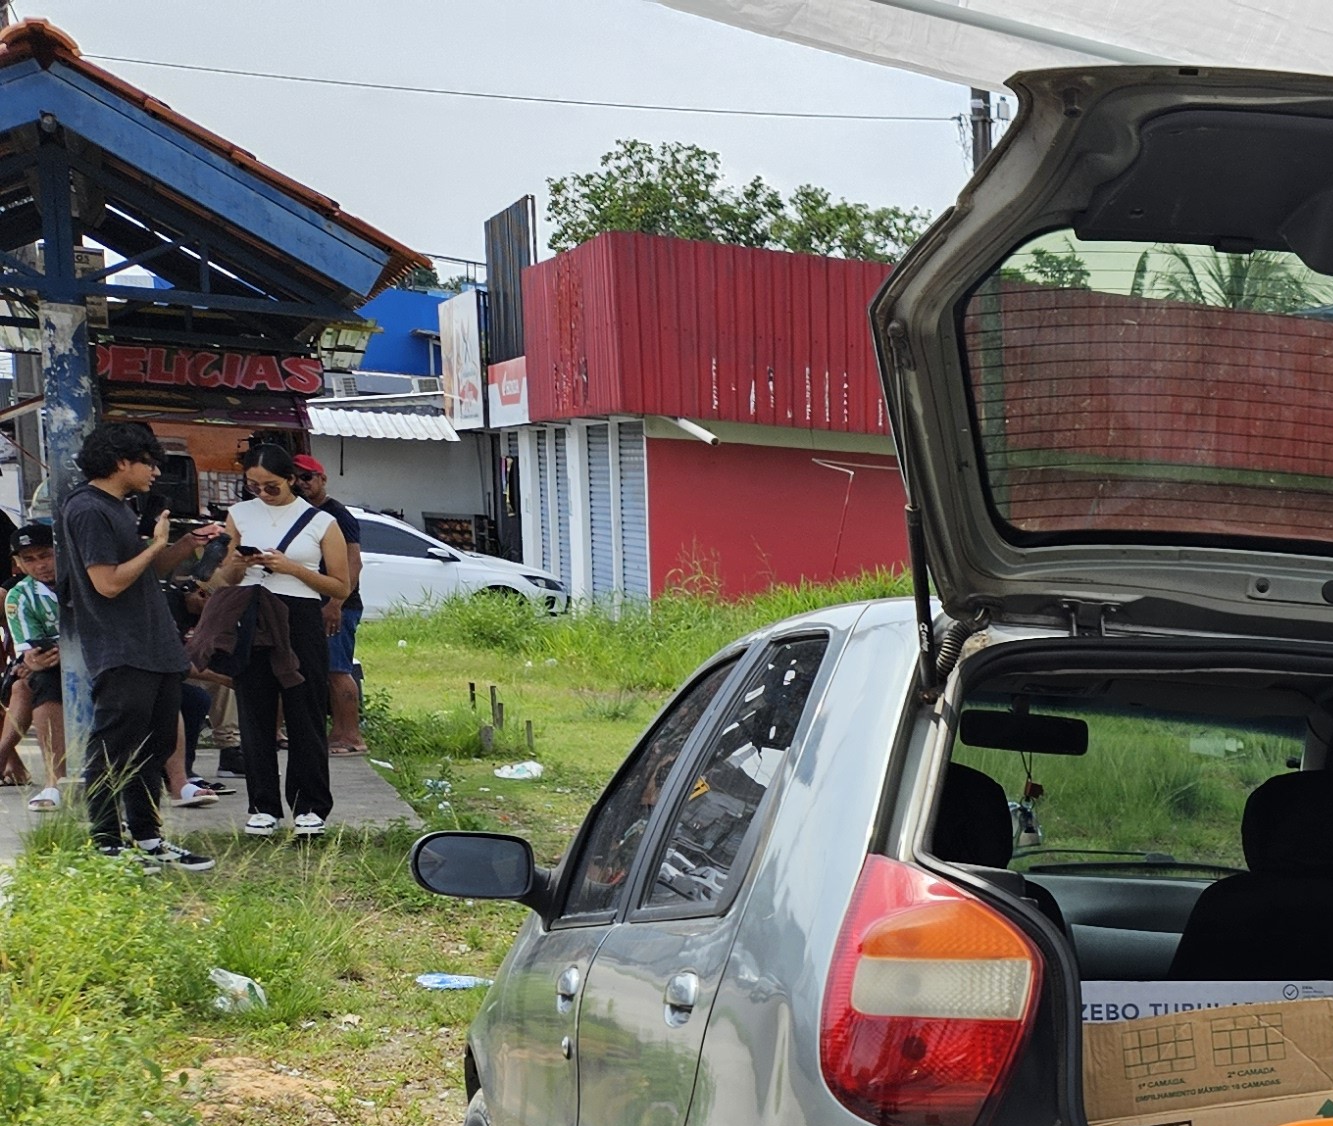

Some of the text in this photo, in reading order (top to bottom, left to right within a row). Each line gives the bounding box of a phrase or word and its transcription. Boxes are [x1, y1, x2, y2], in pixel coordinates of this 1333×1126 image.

[1237, 1067, 1276, 1077] CAMADA
[1147, 1078, 1186, 1089] CAMADA
[1135, 1089, 1196, 1103] EMPILHAMENTO
[1241, 1079, 1281, 1090] CAMADAS
